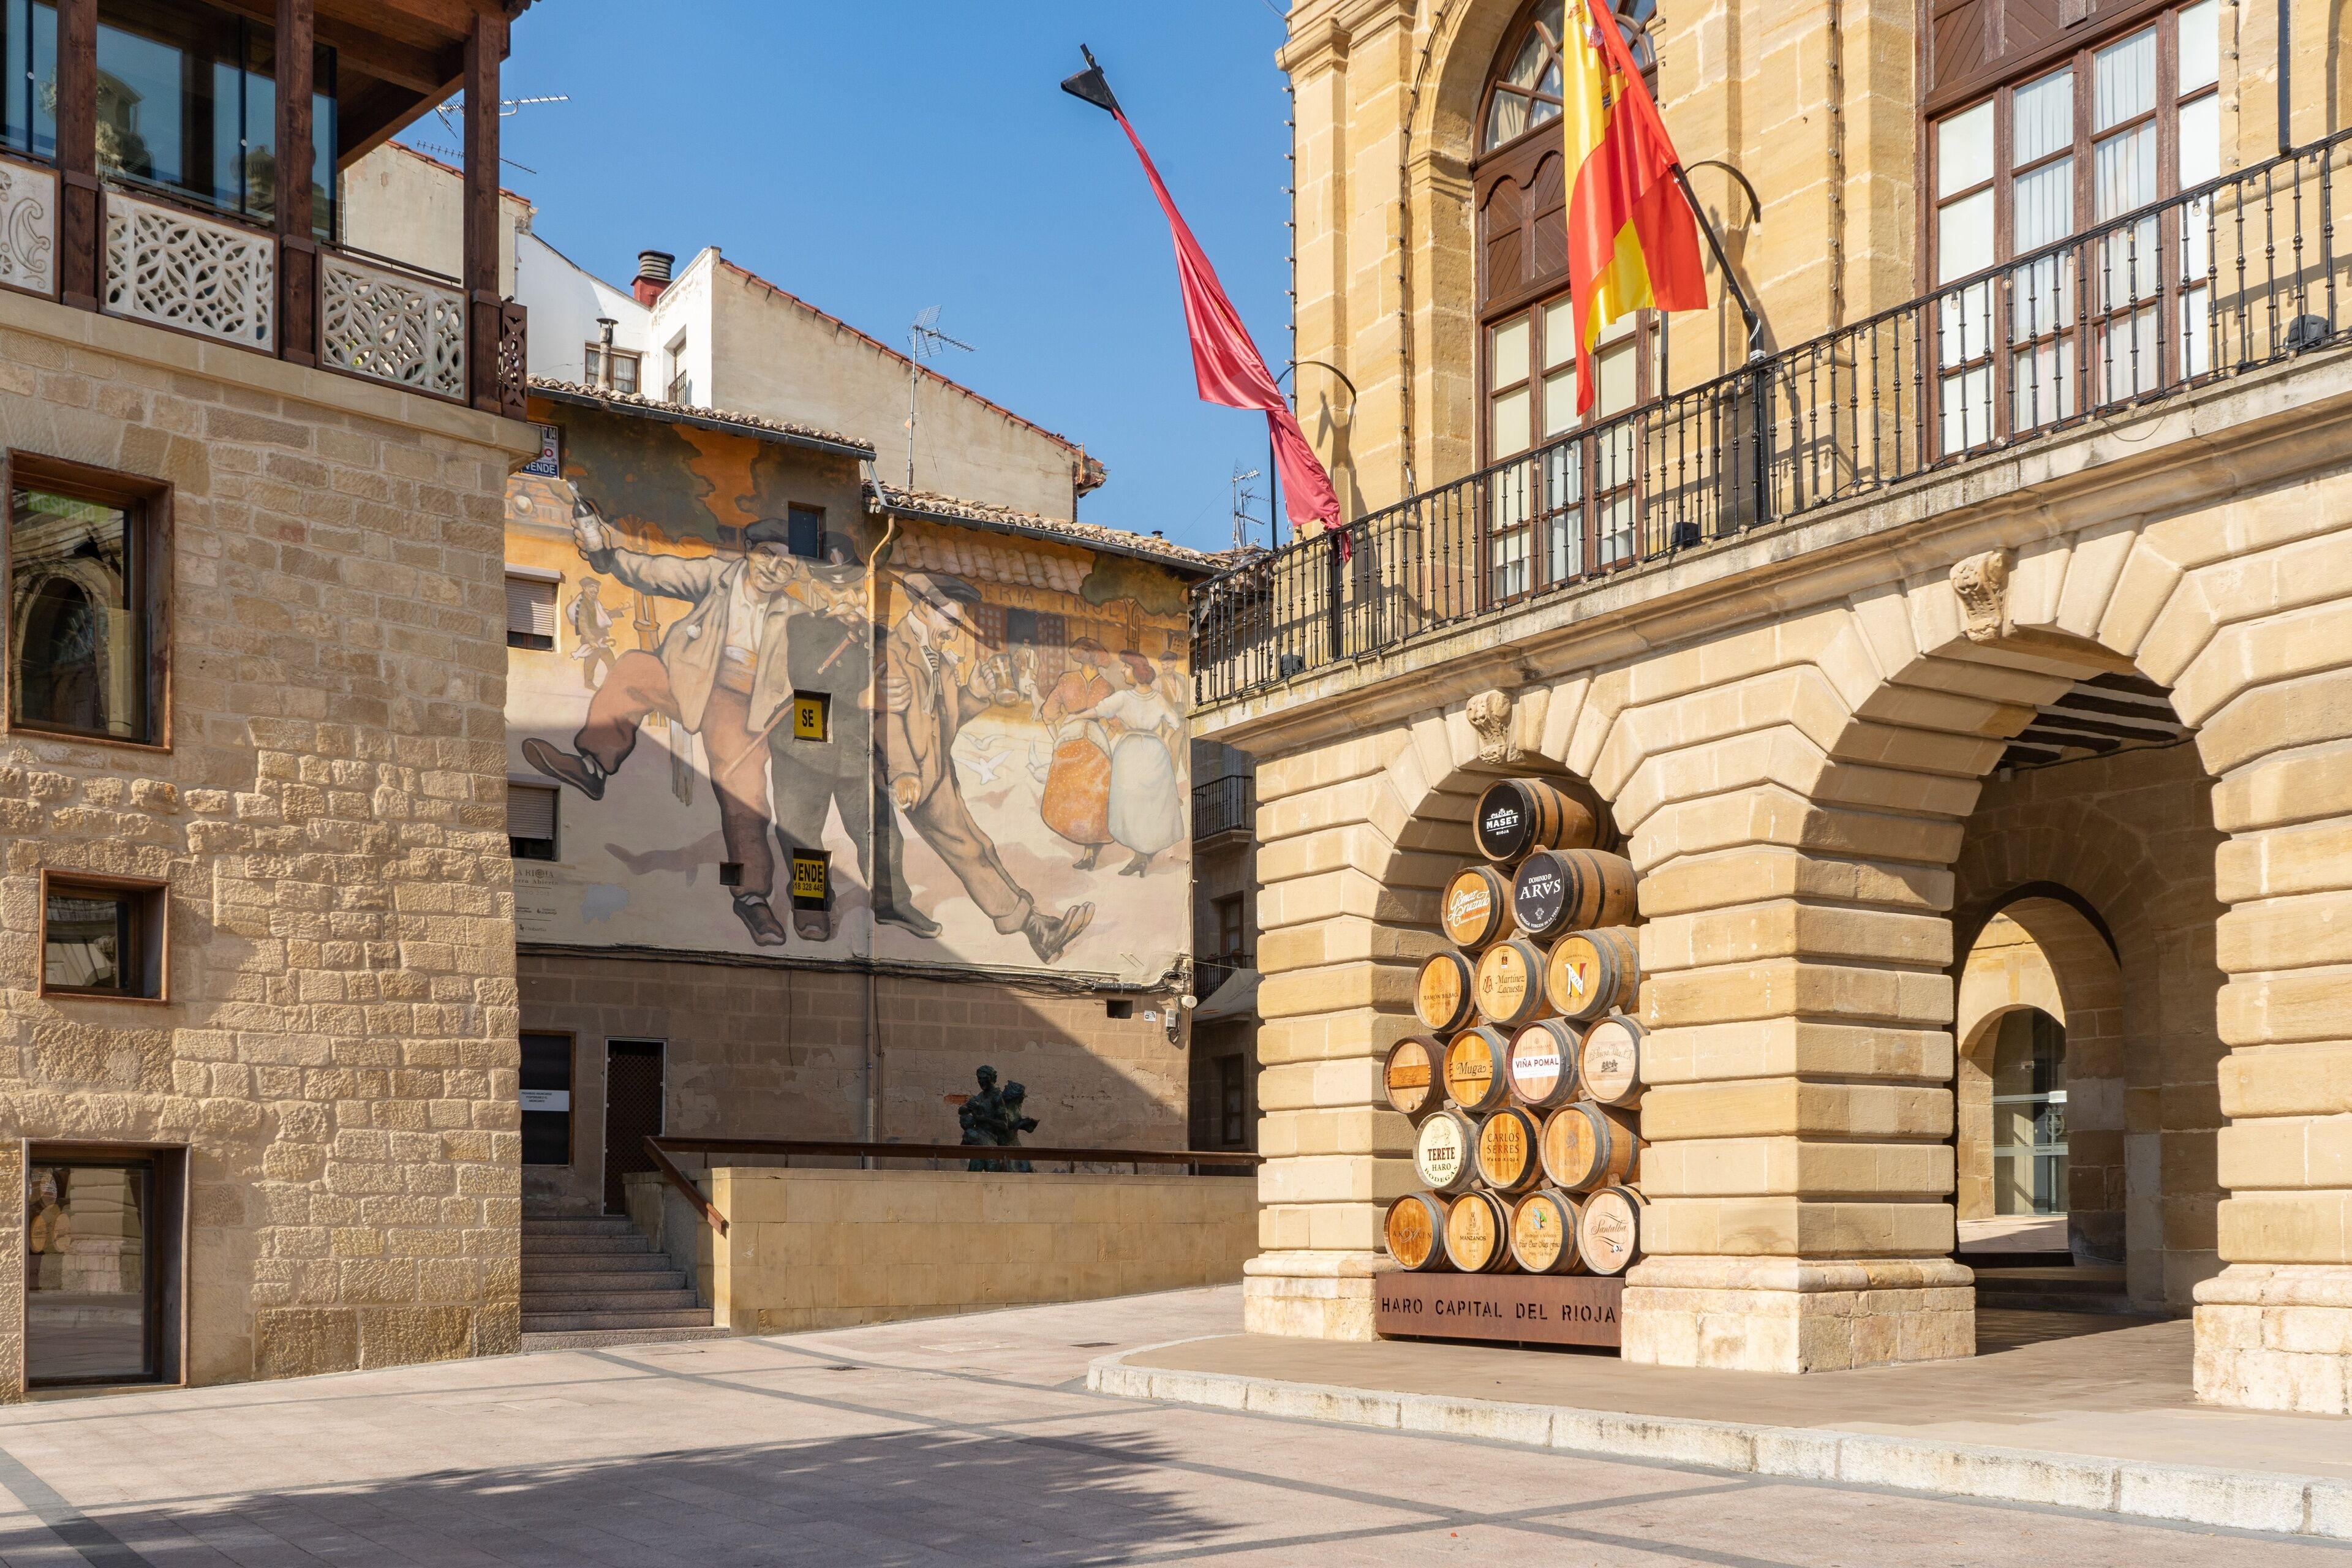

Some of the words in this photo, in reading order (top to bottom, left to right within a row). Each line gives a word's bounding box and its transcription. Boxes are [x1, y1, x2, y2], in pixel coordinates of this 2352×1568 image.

[525, 462, 556, 475] VENDE
[802, 709, 814, 728] SE
[1486, 815, 1518, 830] MASET
[794, 862, 823, 883] VENDE
[1528, 875, 1548, 884] DOMINIO
[802, 883, 812, 891] 328
[1519, 913, 1531, 927] BODEGA
[1495, 973, 1525, 984] Martínez
[1497, 985, 1523, 993] Lacuesta
[1456, 1061, 1487, 1076] Muga
[1515, 1058, 1532, 1068] VIÑA
[1534, 1058, 1559, 1067] POMAL
[1487, 1133, 1520, 1142] CARLOS
[1427, 1147, 1455, 1161] TERETE
[1487, 1144, 1520, 1154] SERRES
[1425, 1165, 1458, 1182] BODEGAS
[1591, 1219, 1627, 1235] Santalba
[1382, 1297, 1423, 1314] HARO
[1435, 1299, 1503, 1319] CAPITAL
[1516, 1302, 1548, 1321] DEL
[1562, 1305, 1617, 1324] RIOJA
